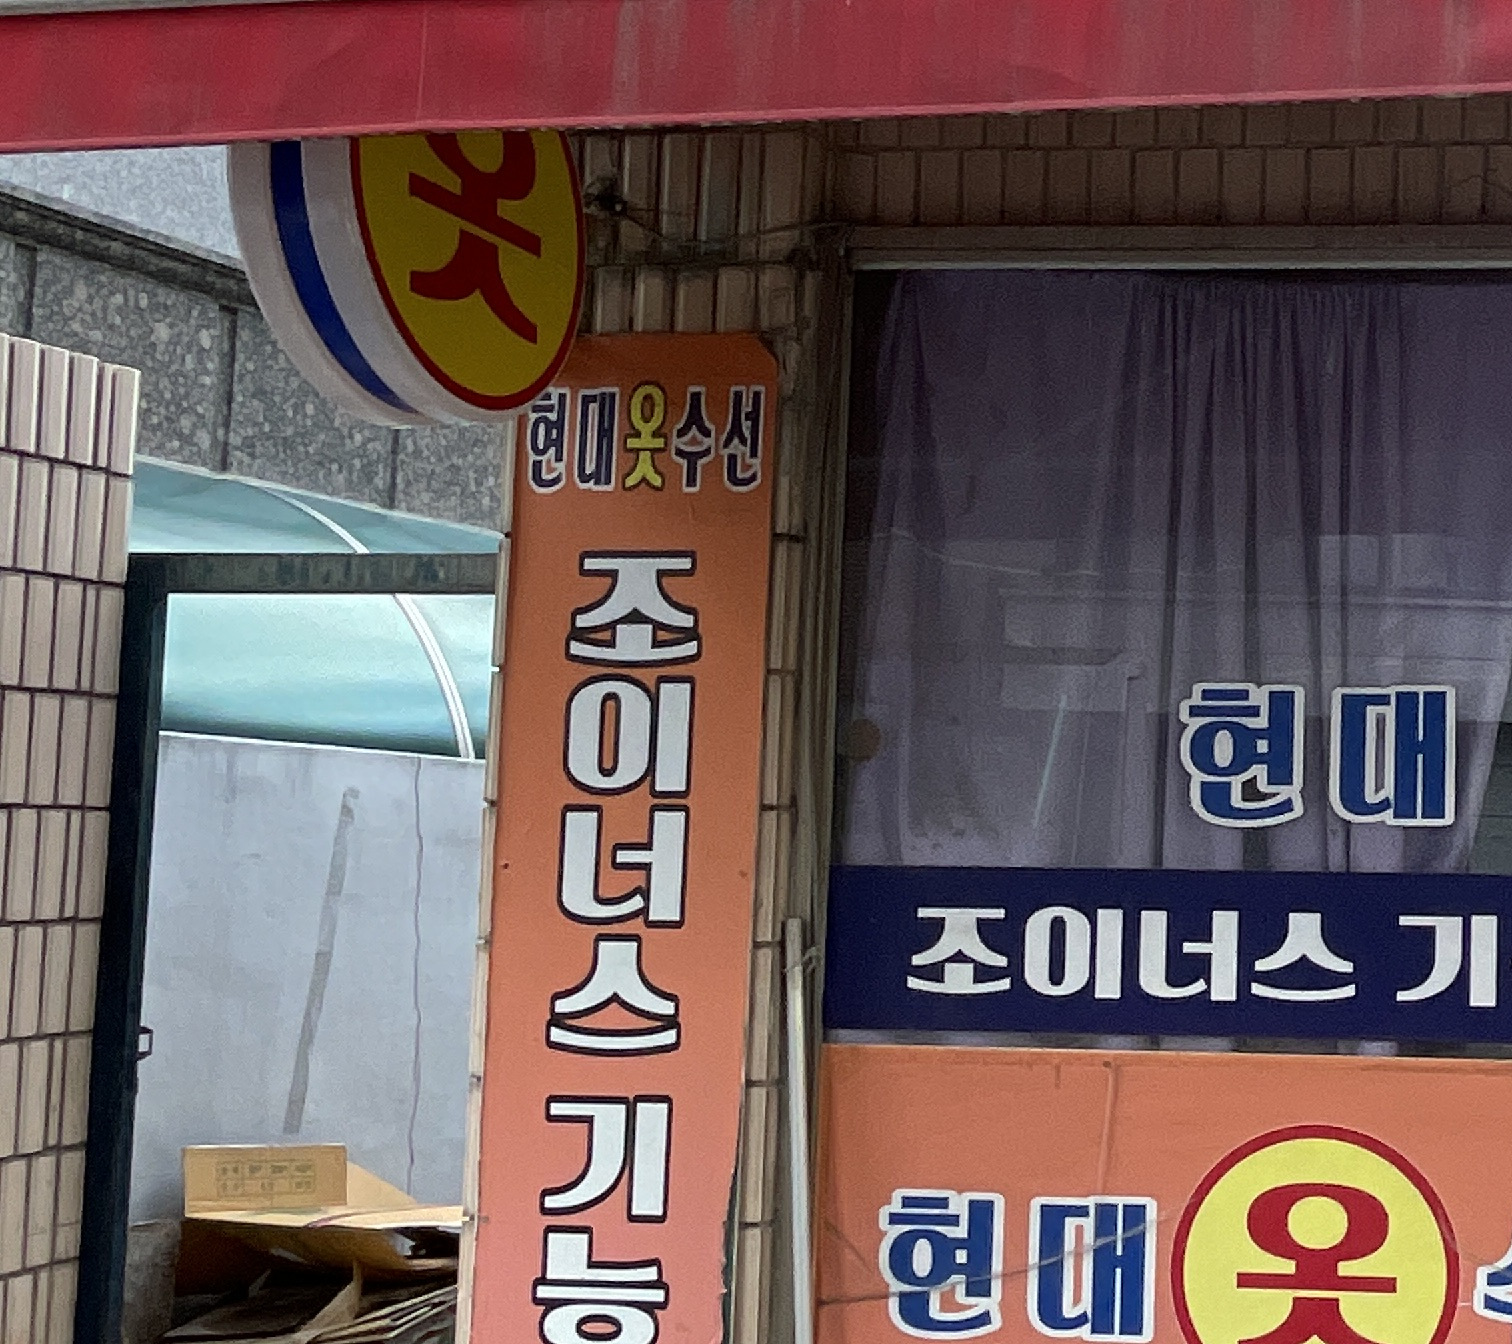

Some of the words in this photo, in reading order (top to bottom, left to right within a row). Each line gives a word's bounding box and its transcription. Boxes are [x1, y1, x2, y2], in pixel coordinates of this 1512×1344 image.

[408, 132, 542, 346] 옷
[527, 380, 766, 494] 현대옷수선
[547, 551, 702, 1057] 조이너스
[1179, 683, 1456, 828] 현대
[906, 905, 1356, 1003] 조이너스
[879, 1188, 1157, 1343] 현대
